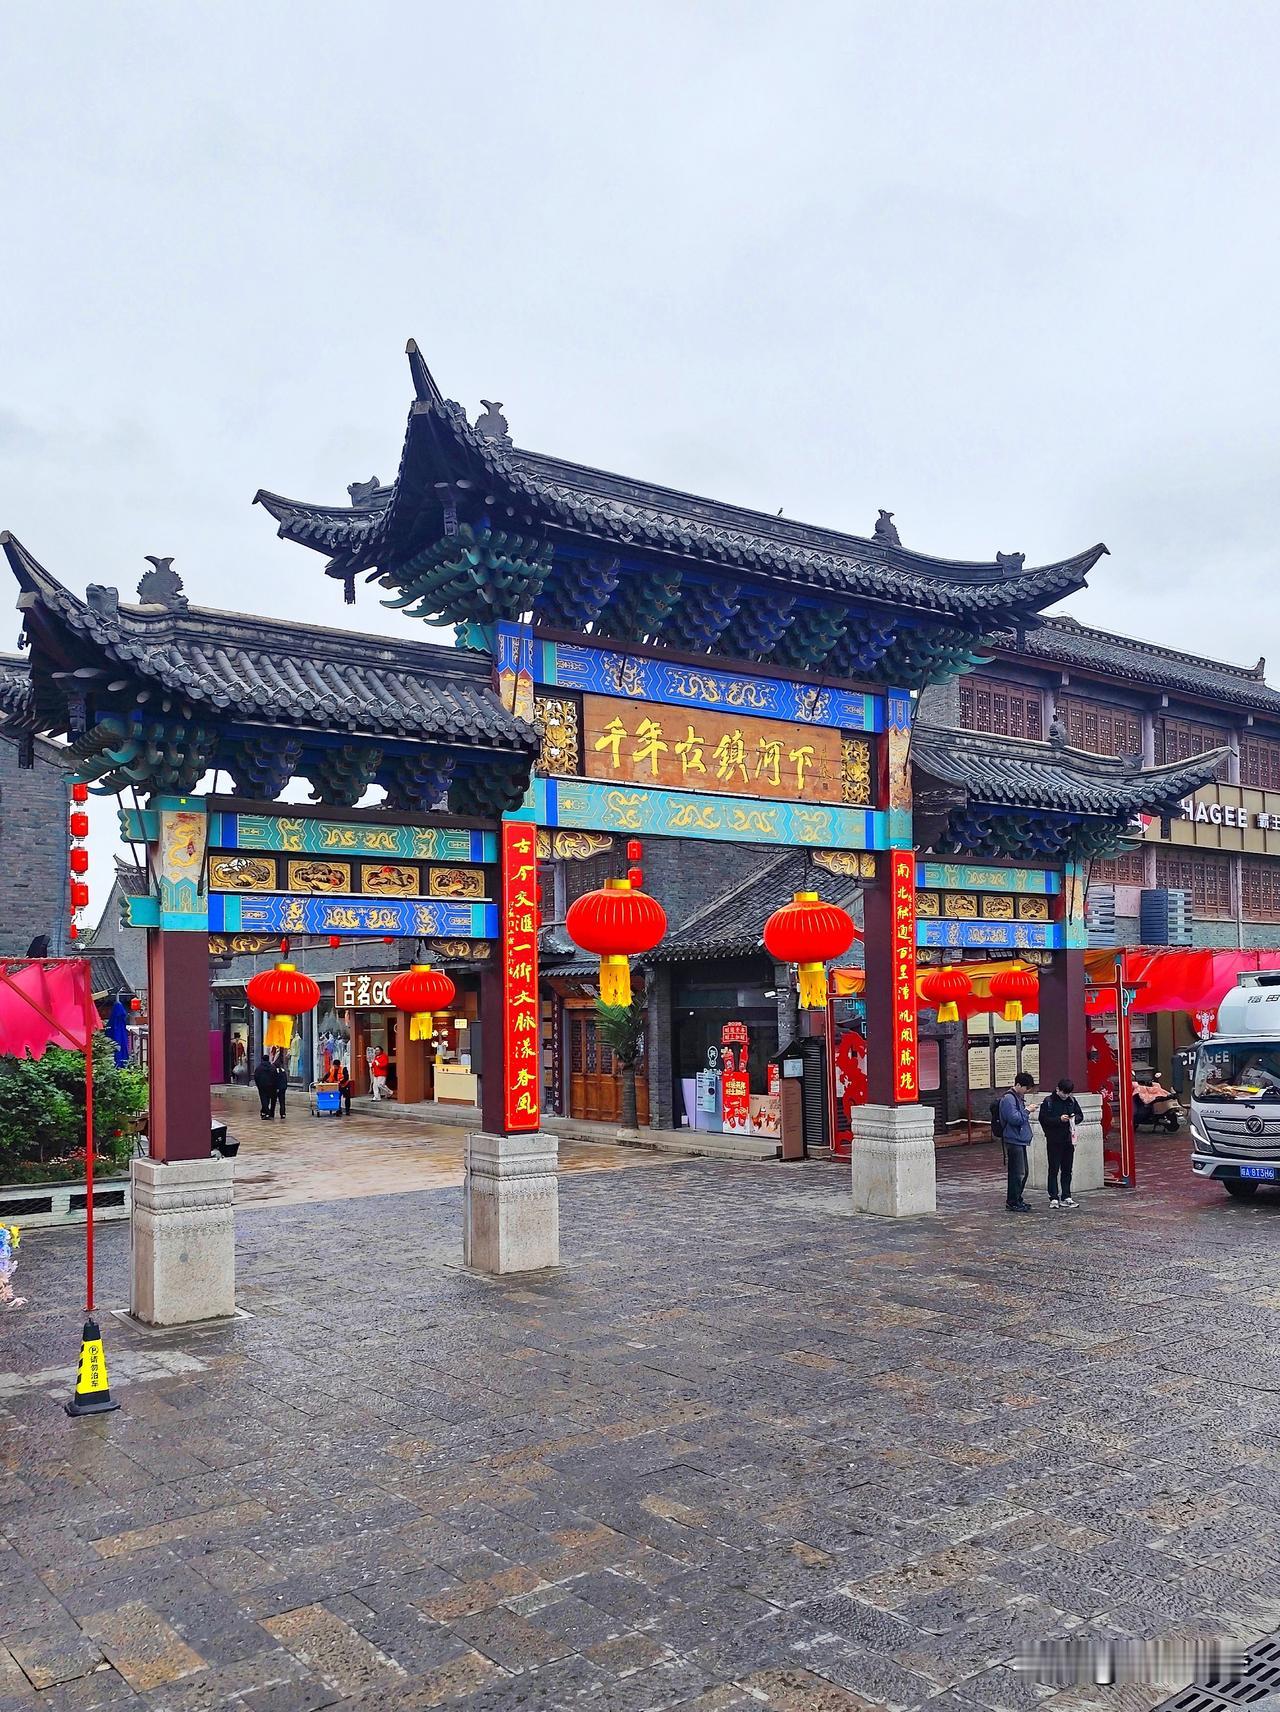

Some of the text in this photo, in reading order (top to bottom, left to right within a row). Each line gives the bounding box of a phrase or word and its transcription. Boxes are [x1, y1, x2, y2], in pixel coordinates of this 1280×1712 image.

[1179, 799, 1248, 828] HAGEE
[90, 1356, 98, 1387] 请勿泊车
